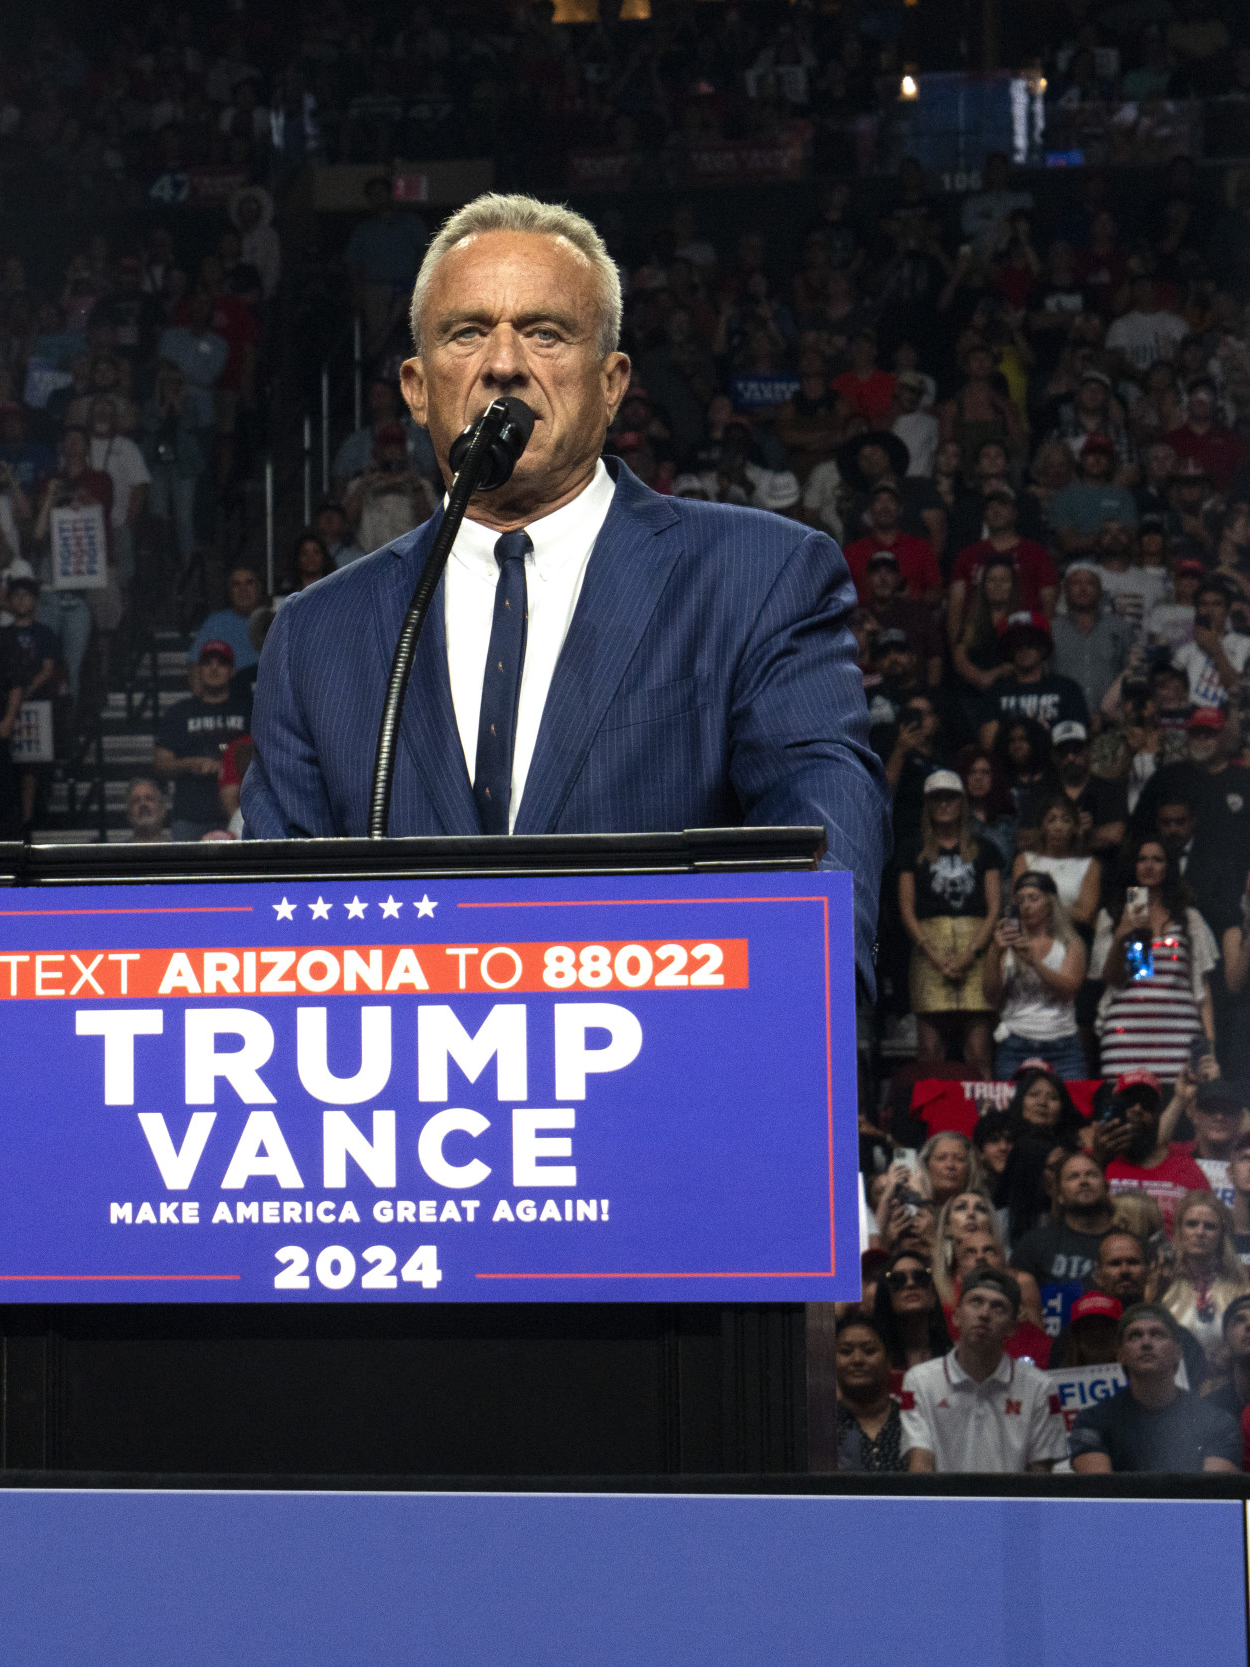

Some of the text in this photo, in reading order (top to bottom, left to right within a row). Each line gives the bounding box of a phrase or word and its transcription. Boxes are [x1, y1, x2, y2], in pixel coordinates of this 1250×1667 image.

[156, 948, 431, 994] ARIZONA
[444, 946, 524, 990] TO
[541, 942, 726, 989] 88022
[75, 1002, 644, 1106] TRUMP
[137, 1106, 578, 1190] VANCE
[109, 1198, 611, 1225] MAKE AMERICA GREAT AGAIN!
[272, 1243, 444, 1291] 2024
